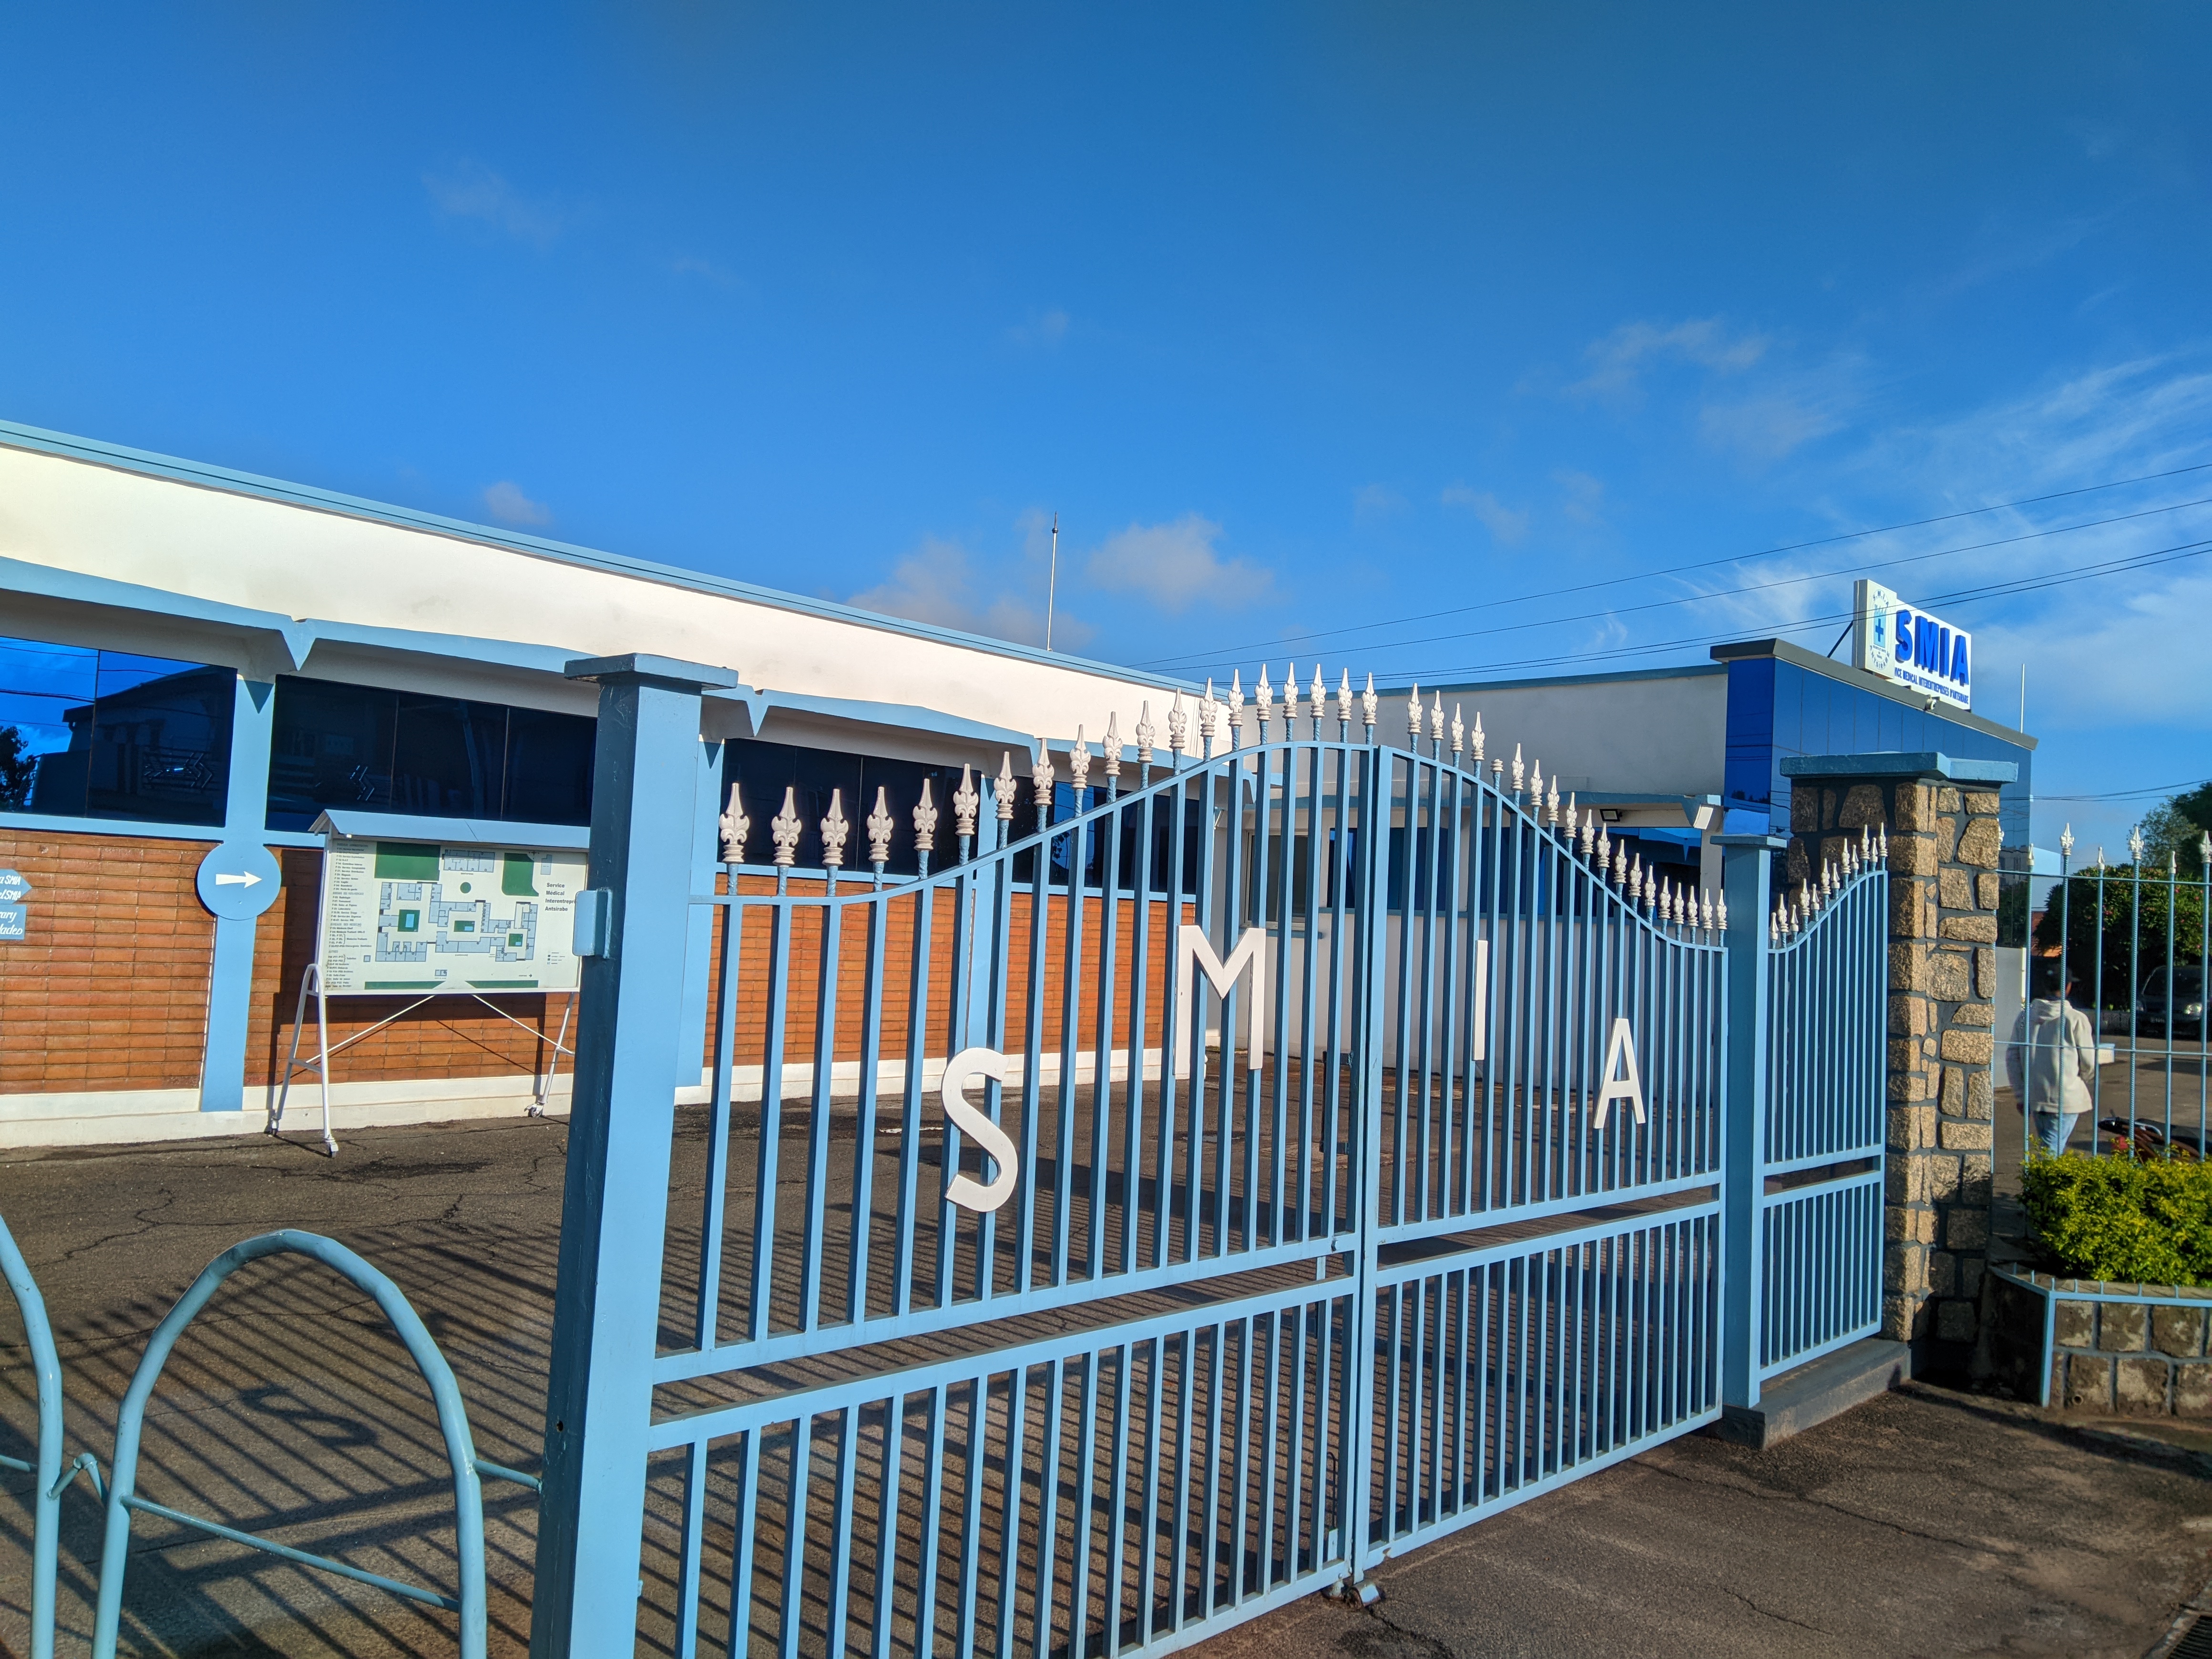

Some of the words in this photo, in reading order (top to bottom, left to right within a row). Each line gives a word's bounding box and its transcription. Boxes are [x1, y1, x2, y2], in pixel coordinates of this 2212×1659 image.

[1895, 609, 1969, 686] SMIA
[4, 875, 21, 885] SMIA
[4, 890, 21, 901] SMIA
